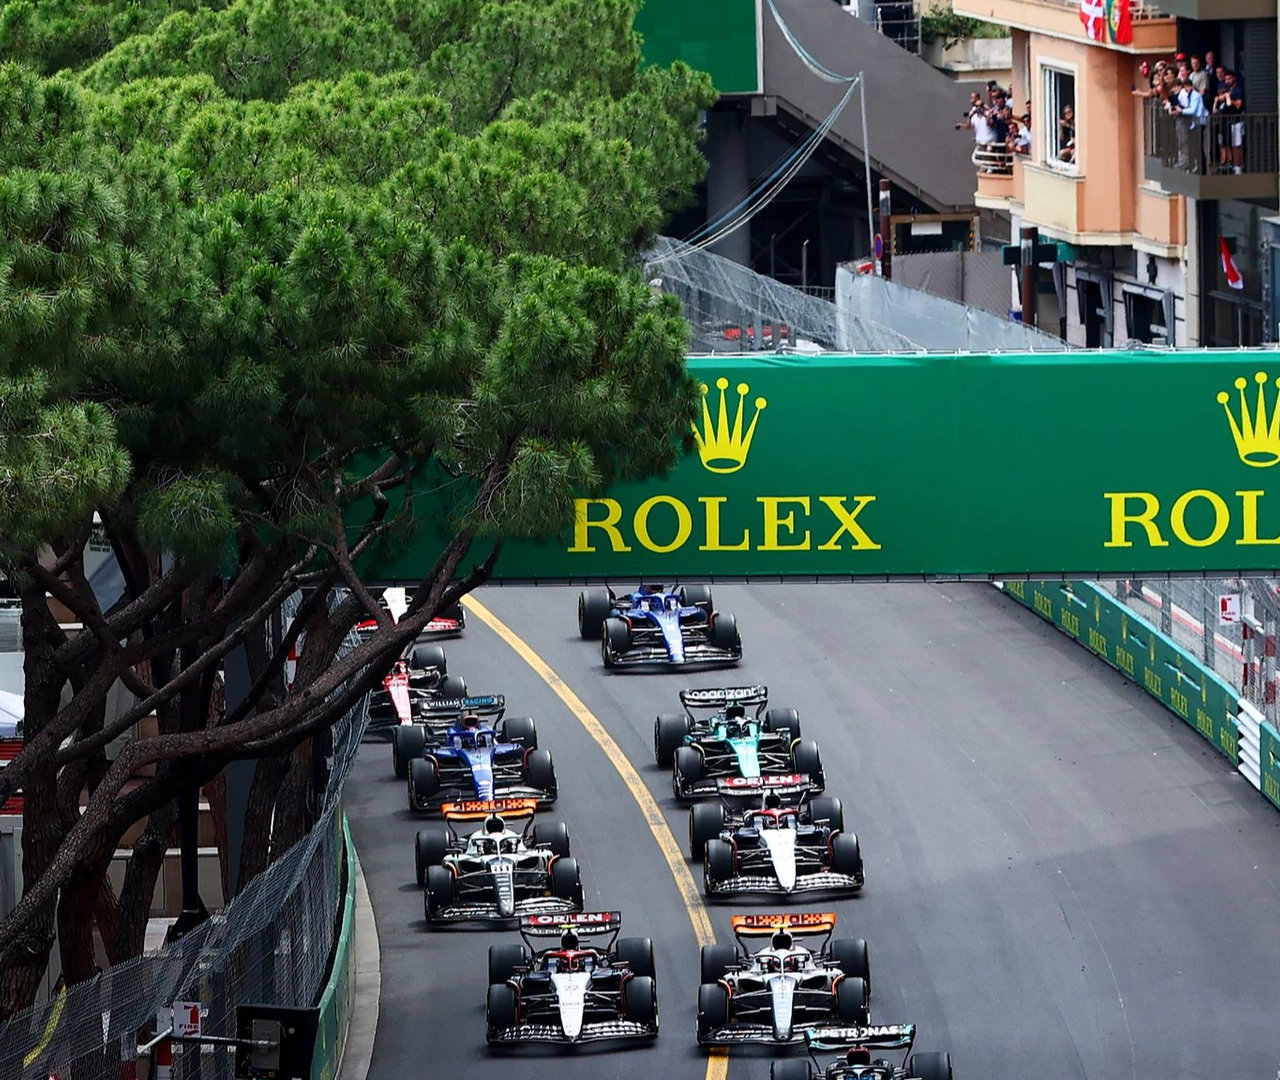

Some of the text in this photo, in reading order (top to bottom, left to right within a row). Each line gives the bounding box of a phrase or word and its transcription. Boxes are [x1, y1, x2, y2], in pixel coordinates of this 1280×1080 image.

[568, 495, 880, 553] ROLEX
[733, 776, 793, 785] ORLEN
[537, 914, 602, 923] ORLEN
[820, 1026, 899, 1038] PETRONAS
